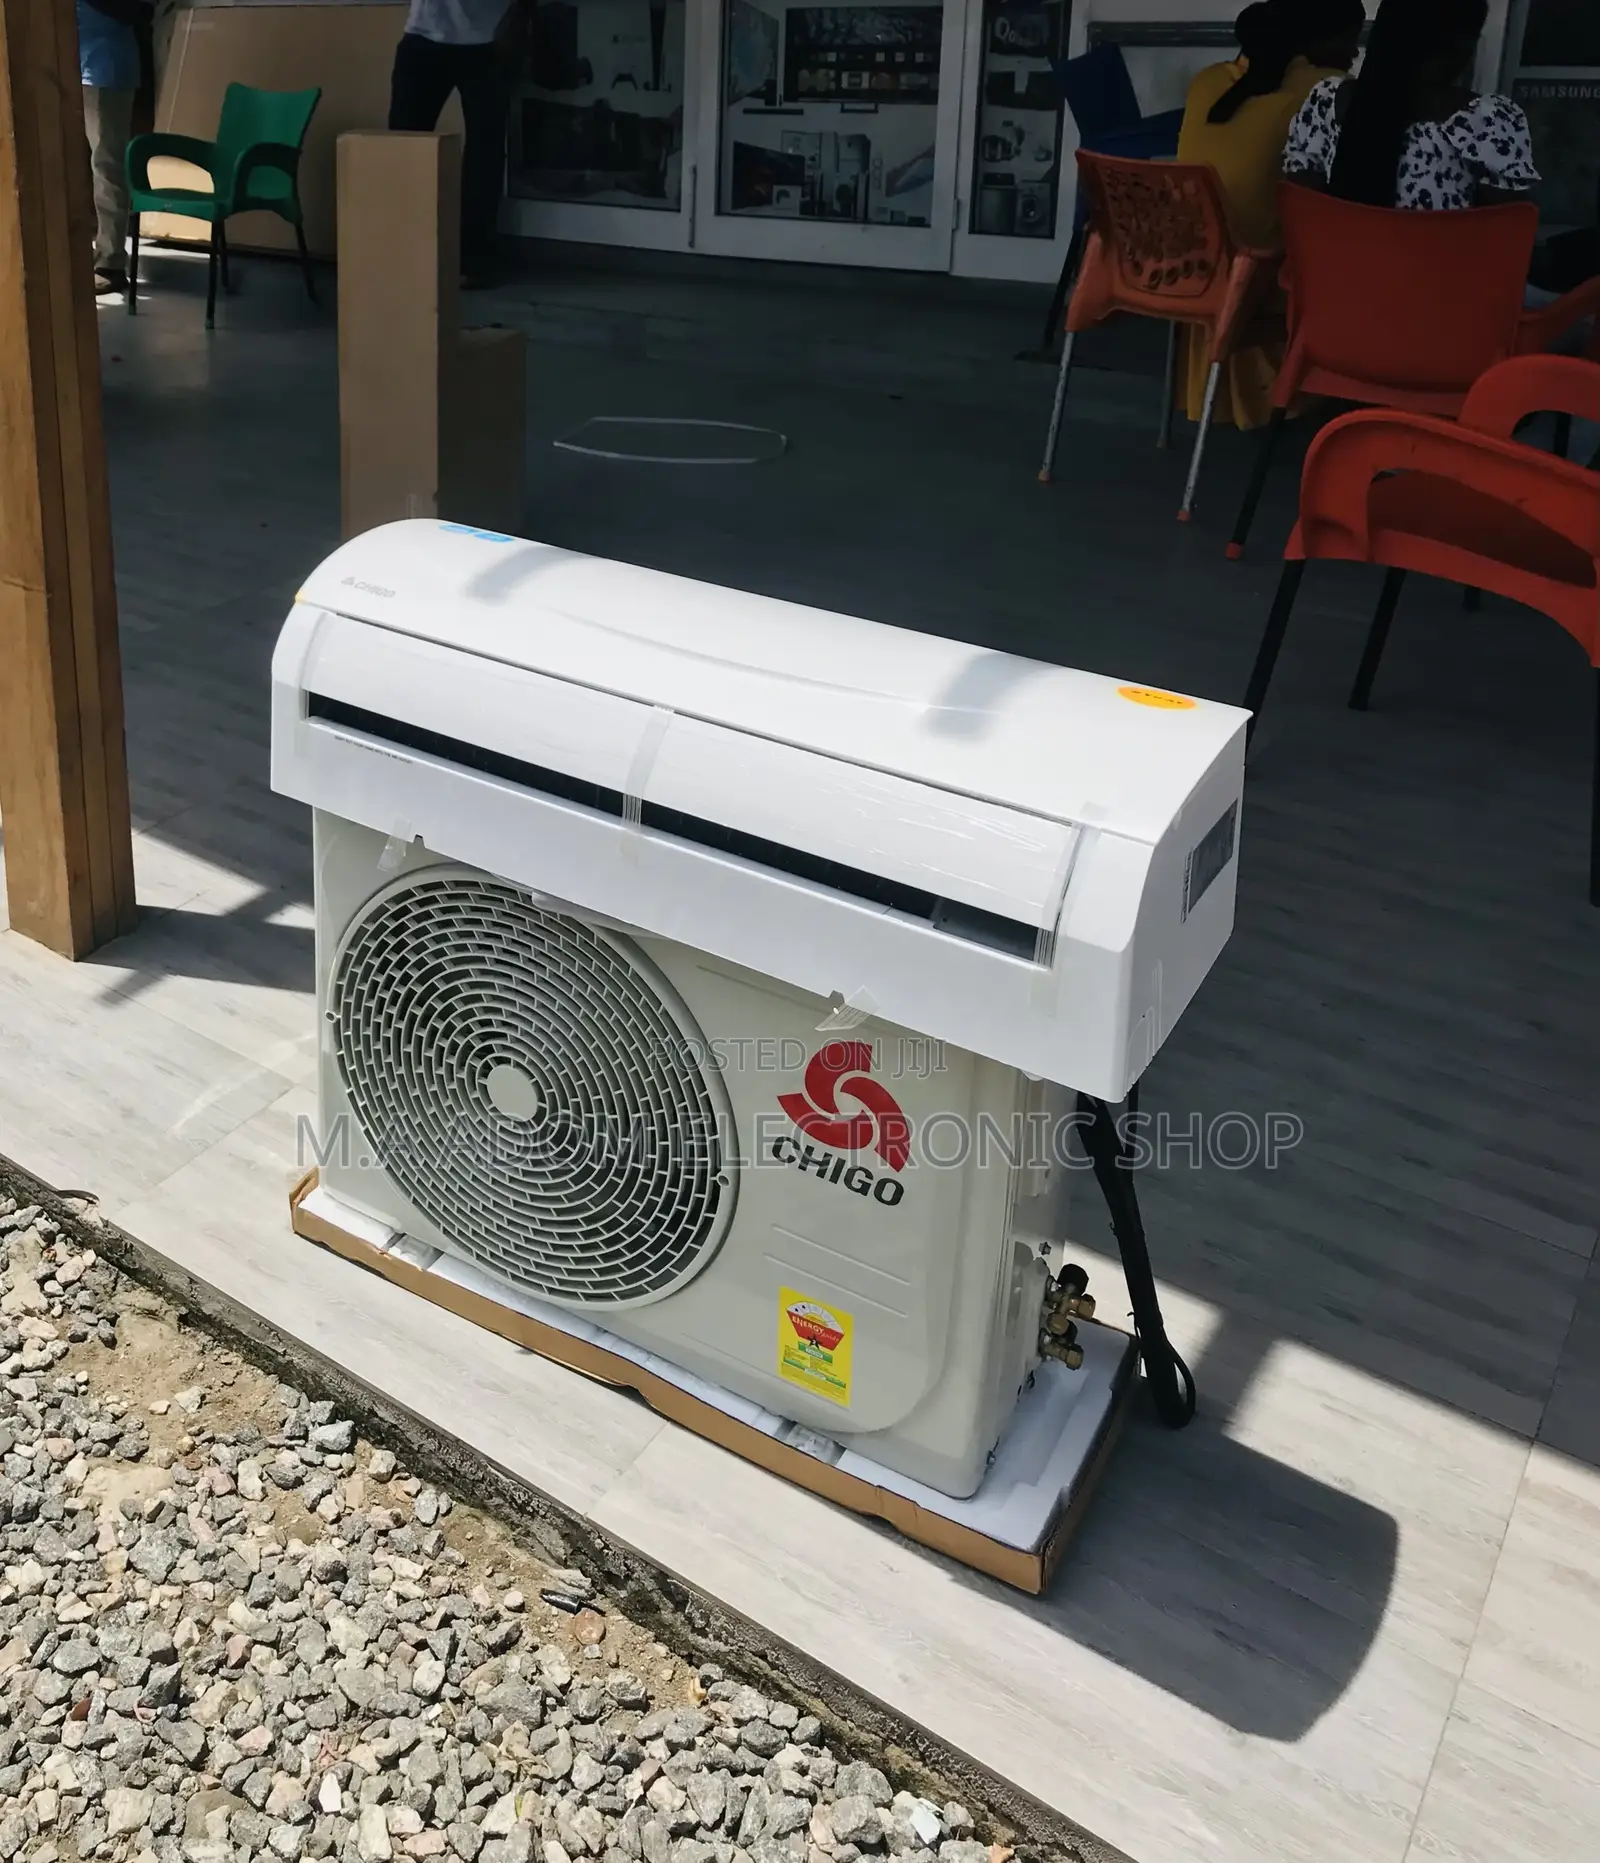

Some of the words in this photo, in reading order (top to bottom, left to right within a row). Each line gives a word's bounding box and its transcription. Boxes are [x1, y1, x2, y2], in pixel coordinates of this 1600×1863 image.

[1520, 85, 1600, 99] SAMSUNG
[354, 581, 396, 598] CHIGO
[771, 1135, 905, 1206] CHIGO
[791, 1315, 825, 1334] ENERGY
